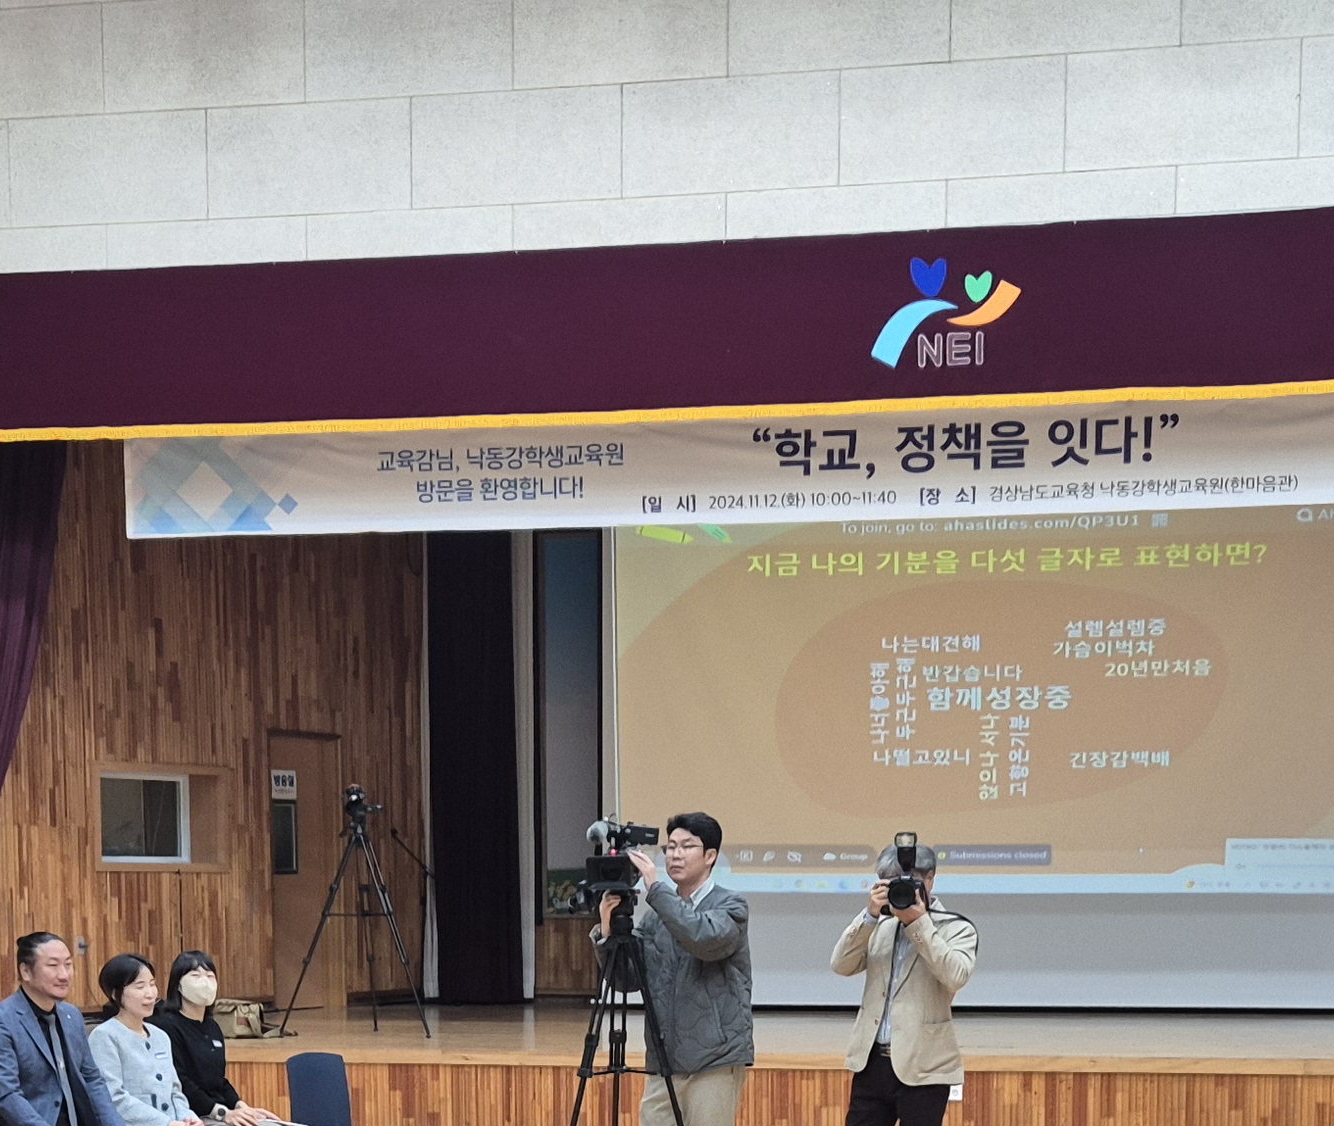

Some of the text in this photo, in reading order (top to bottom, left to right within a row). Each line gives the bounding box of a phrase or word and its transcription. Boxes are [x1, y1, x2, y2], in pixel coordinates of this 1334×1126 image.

[917, 330, 985, 369] NEI
[377, 442, 625, 474] 교육감님, 낙동강학생교육원
[895, 420, 1030, 473] 정책을
[416, 475, 584, 503] 방문을 환영합니다!
[811, 489, 898, 506] 10:00~11:40
[989, 480, 1095, 503] 경상남도교육청
[1100, 474, 1300, 501] 낙동강학생교육원(한마음관)
[841, 521, 857, 534] To
[896, 522, 915, 536] go
[747, 541, 1267, 577] 지금 나의 기분을 다섯 글자로 표현하면?
[881, 634, 981, 654] 나는대견해
[1052, 639, 1156, 659] 가슴이벅차
[922, 664, 1023, 683] 반갑습니다
[1104, 658, 1212, 678] 20년만처음
[927, 685, 1073, 711] 함께성장중
[1069, 749, 1171, 769] 긴장감백배
